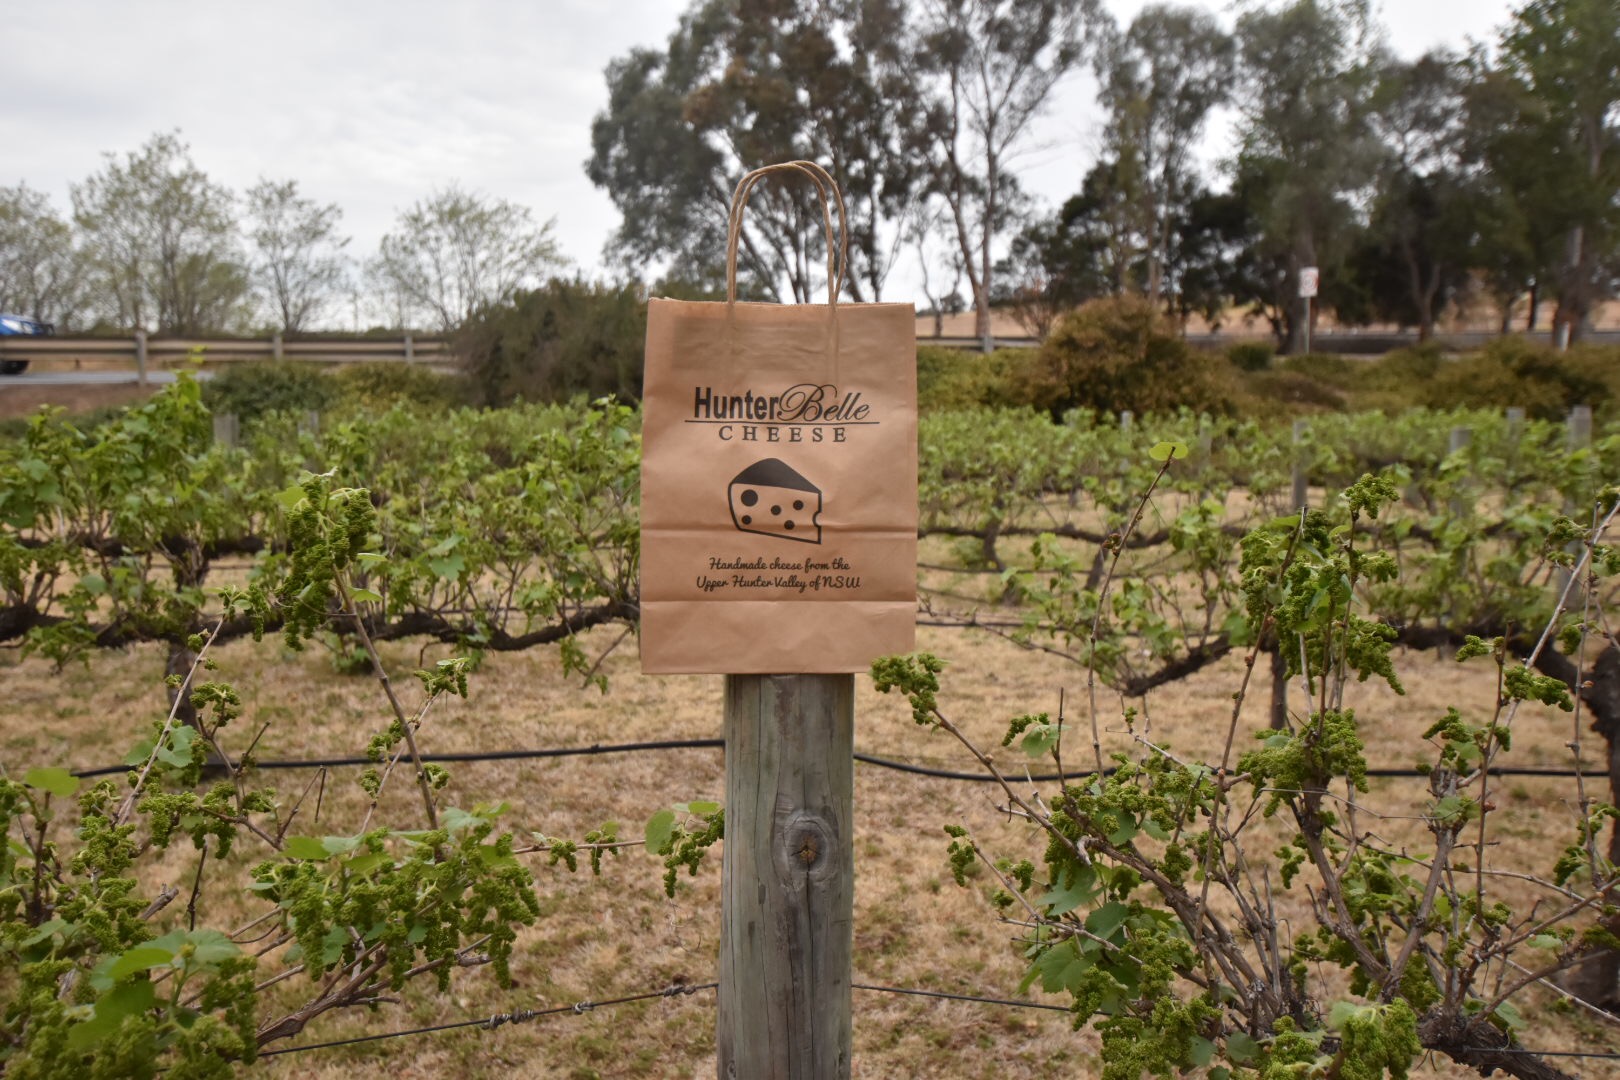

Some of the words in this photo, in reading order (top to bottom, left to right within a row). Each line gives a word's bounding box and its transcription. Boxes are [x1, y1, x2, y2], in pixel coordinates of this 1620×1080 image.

[718, 425, 847, 443] CHEESE
[709, 557, 767, 571] Handmade
[769, 558, 802, 571] cheese
[804, 558, 829, 573] from
[831, 557, 850, 571] the
[696, 576, 729, 591] Upper
[732, 575, 773, 589] Hunter
[774, 576, 806, 592] Valley
[809, 576, 822, 591] of
[822, 576, 860, 589] NSW
